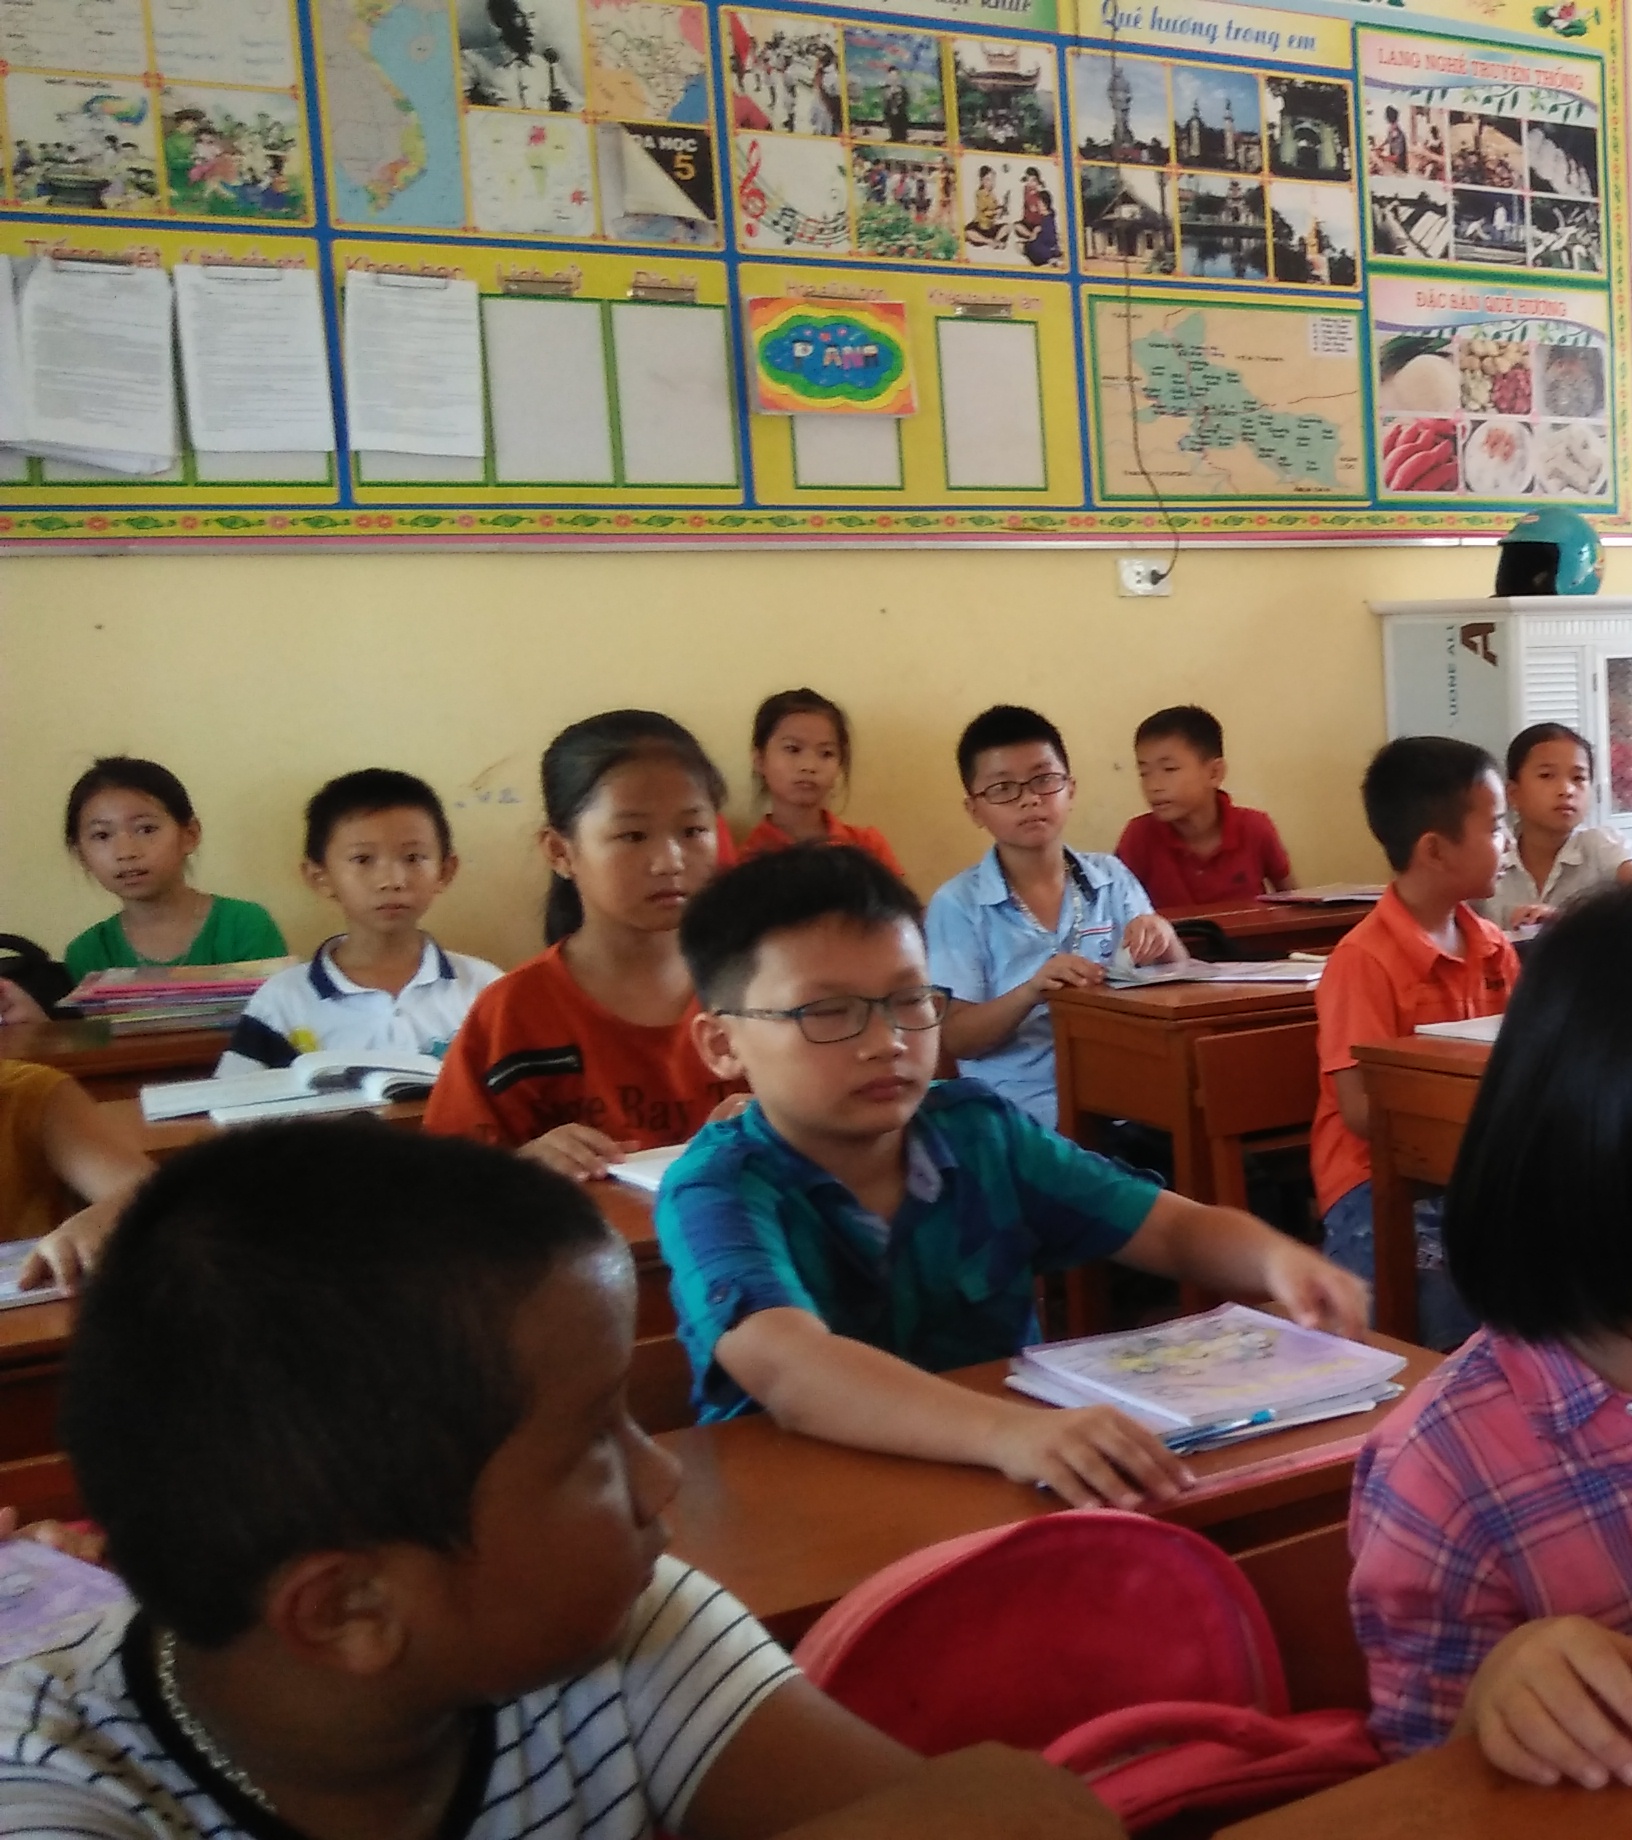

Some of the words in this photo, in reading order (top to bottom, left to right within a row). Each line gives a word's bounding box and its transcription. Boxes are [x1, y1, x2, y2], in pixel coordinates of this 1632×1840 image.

[1225, 19, 1280, 52] trong
[1287, 34, 1316, 50] em
[673, 153, 695, 180] 5
